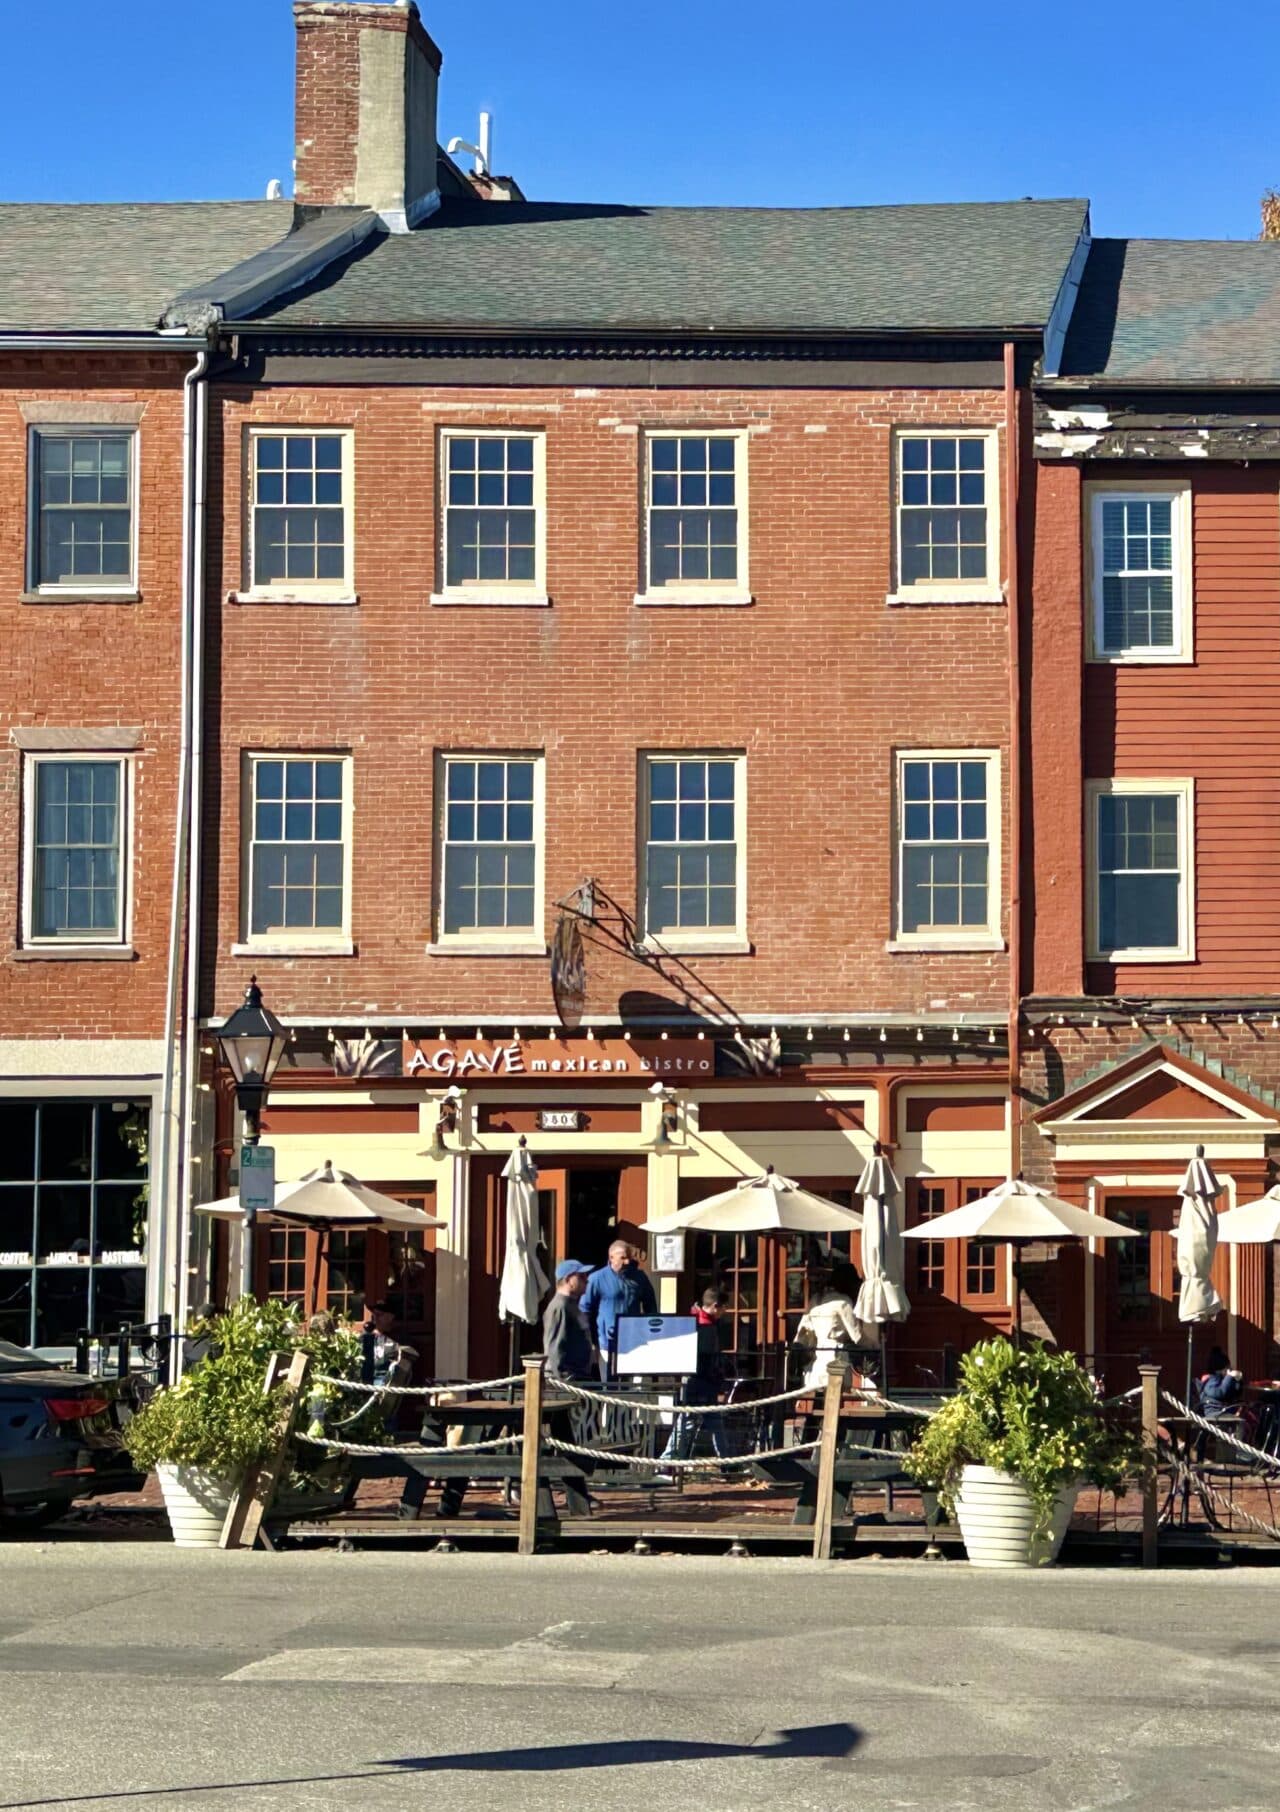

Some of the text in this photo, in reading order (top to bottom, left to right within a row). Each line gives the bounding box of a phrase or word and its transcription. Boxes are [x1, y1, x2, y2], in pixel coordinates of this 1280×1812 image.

[406, 1042, 710, 1076] AGAVÉ mexican bistro
